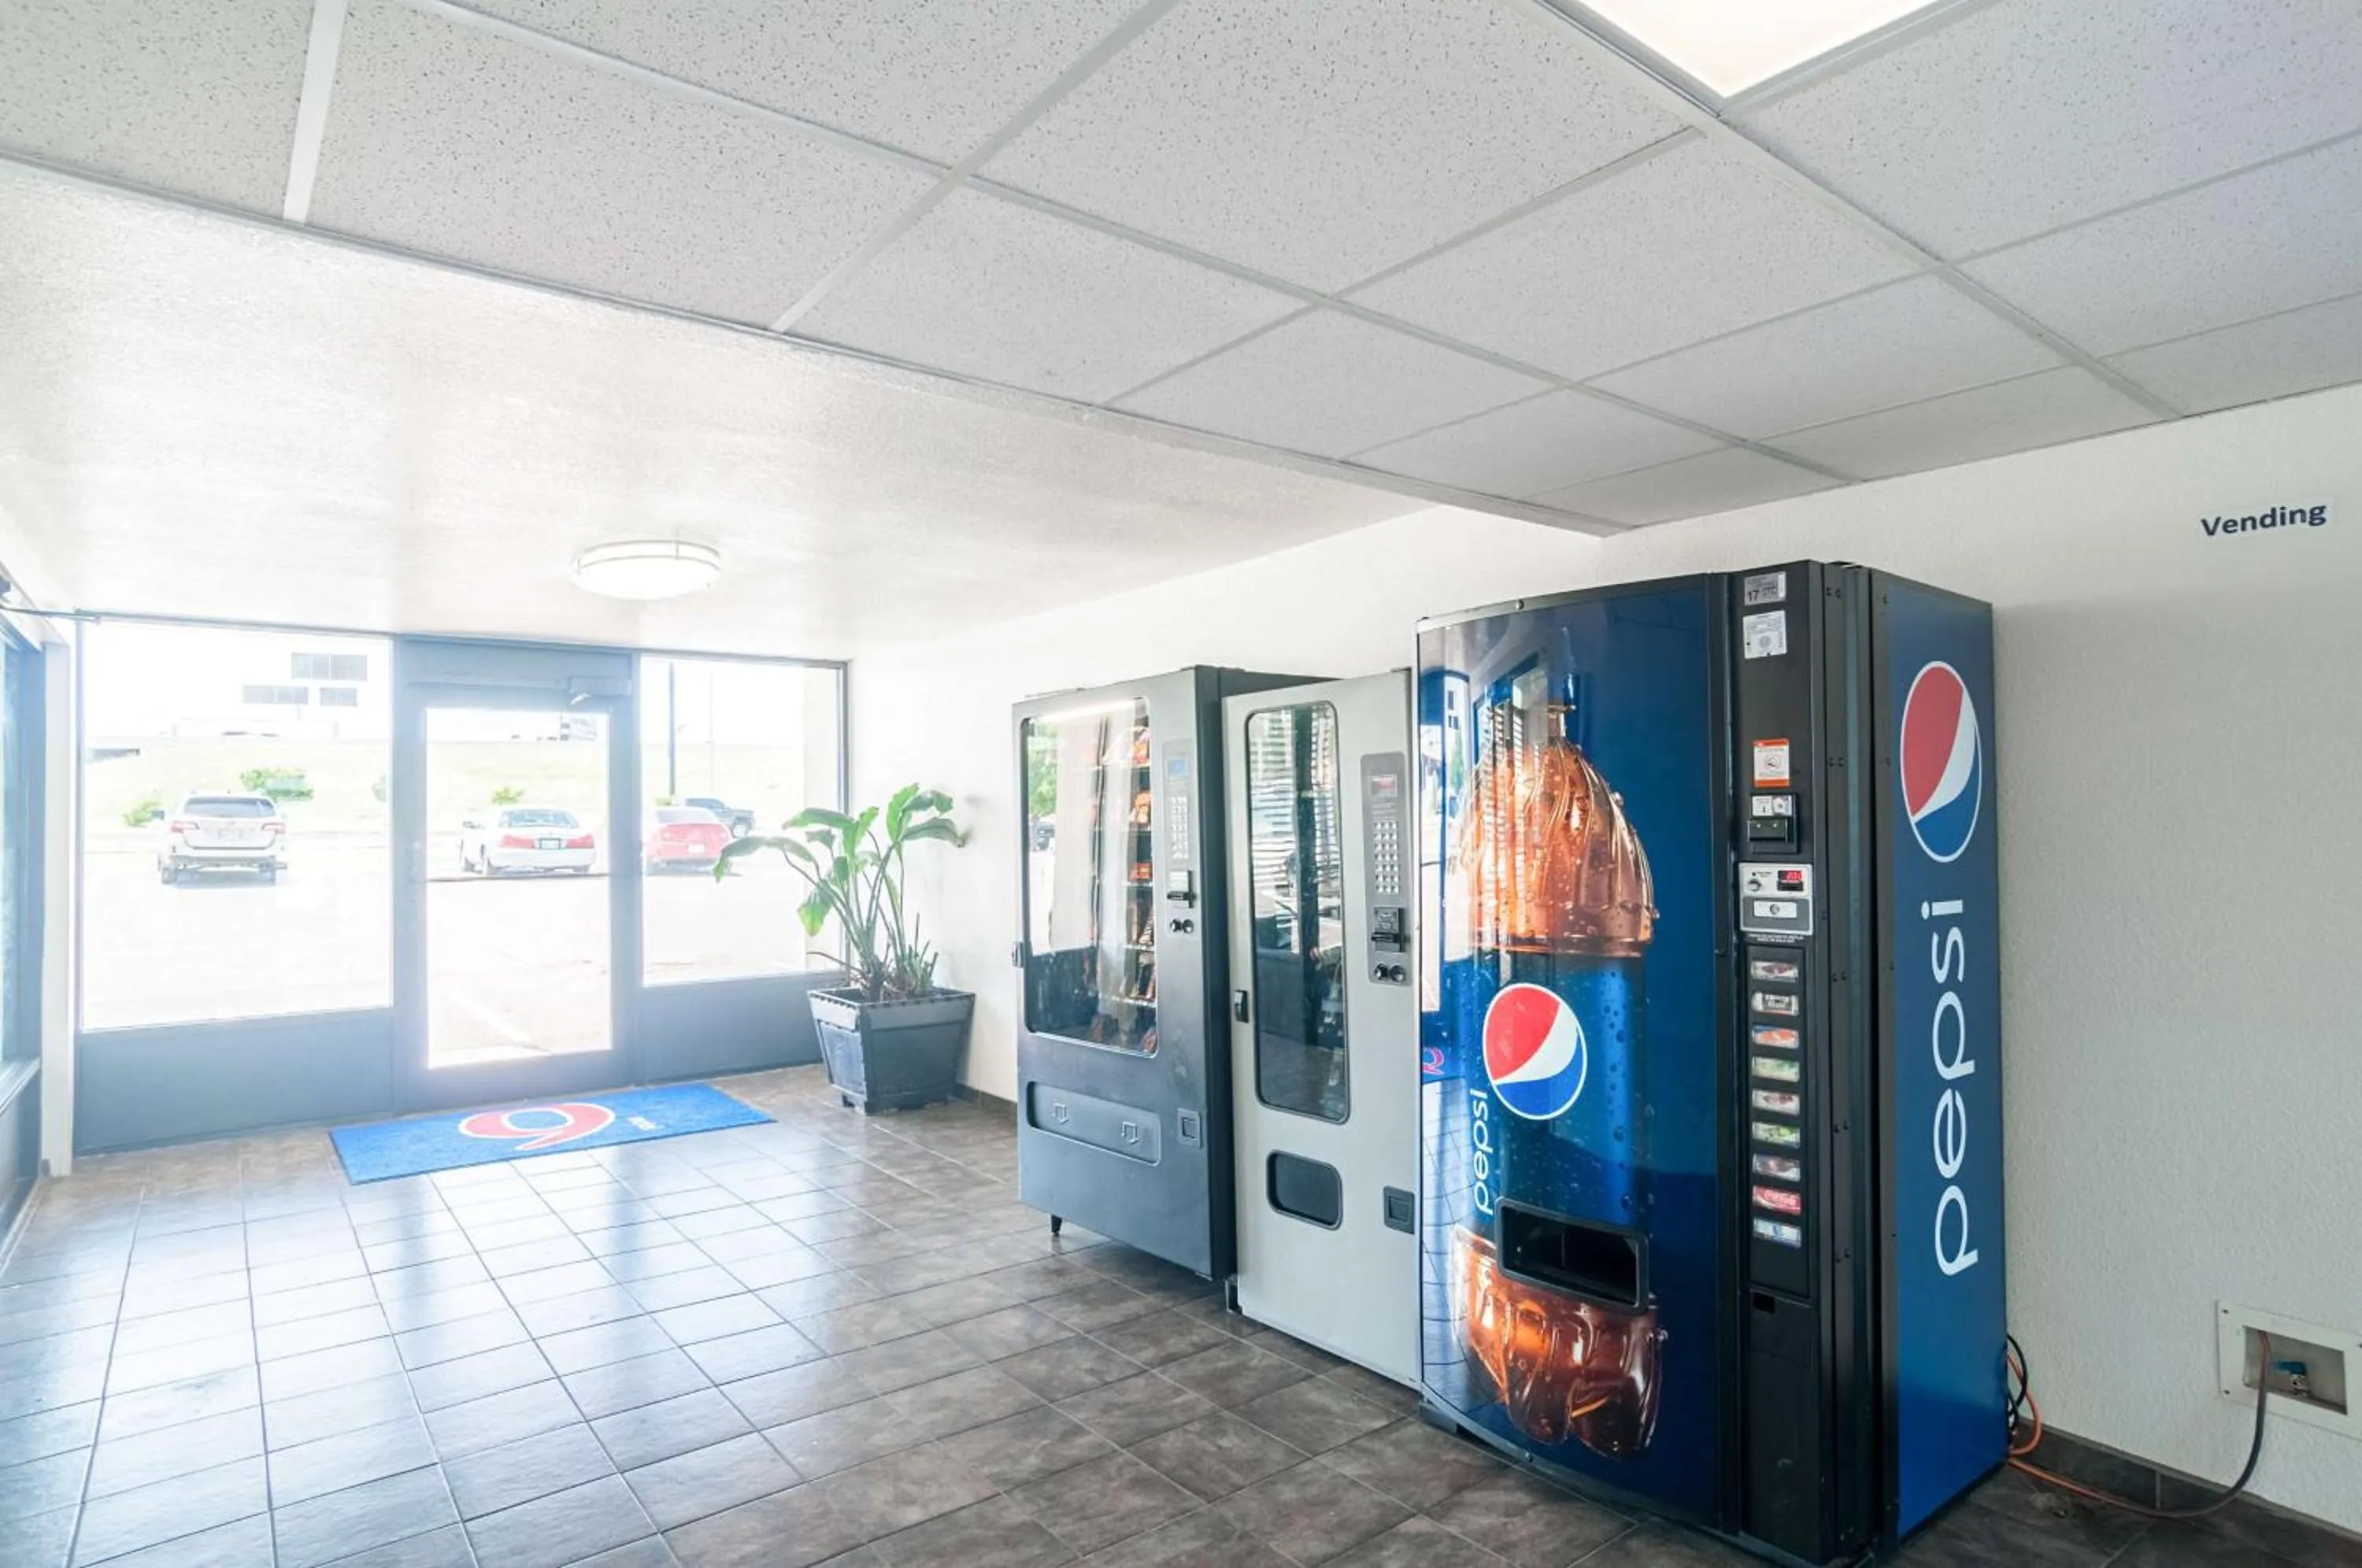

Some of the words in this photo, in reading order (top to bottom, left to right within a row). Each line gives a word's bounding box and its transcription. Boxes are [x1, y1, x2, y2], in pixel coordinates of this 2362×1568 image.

[2201, 505, 2327, 536] Vending
[1921, 900, 1978, 1276] pepsi
[1470, 1089, 1493, 1215] pepsi
